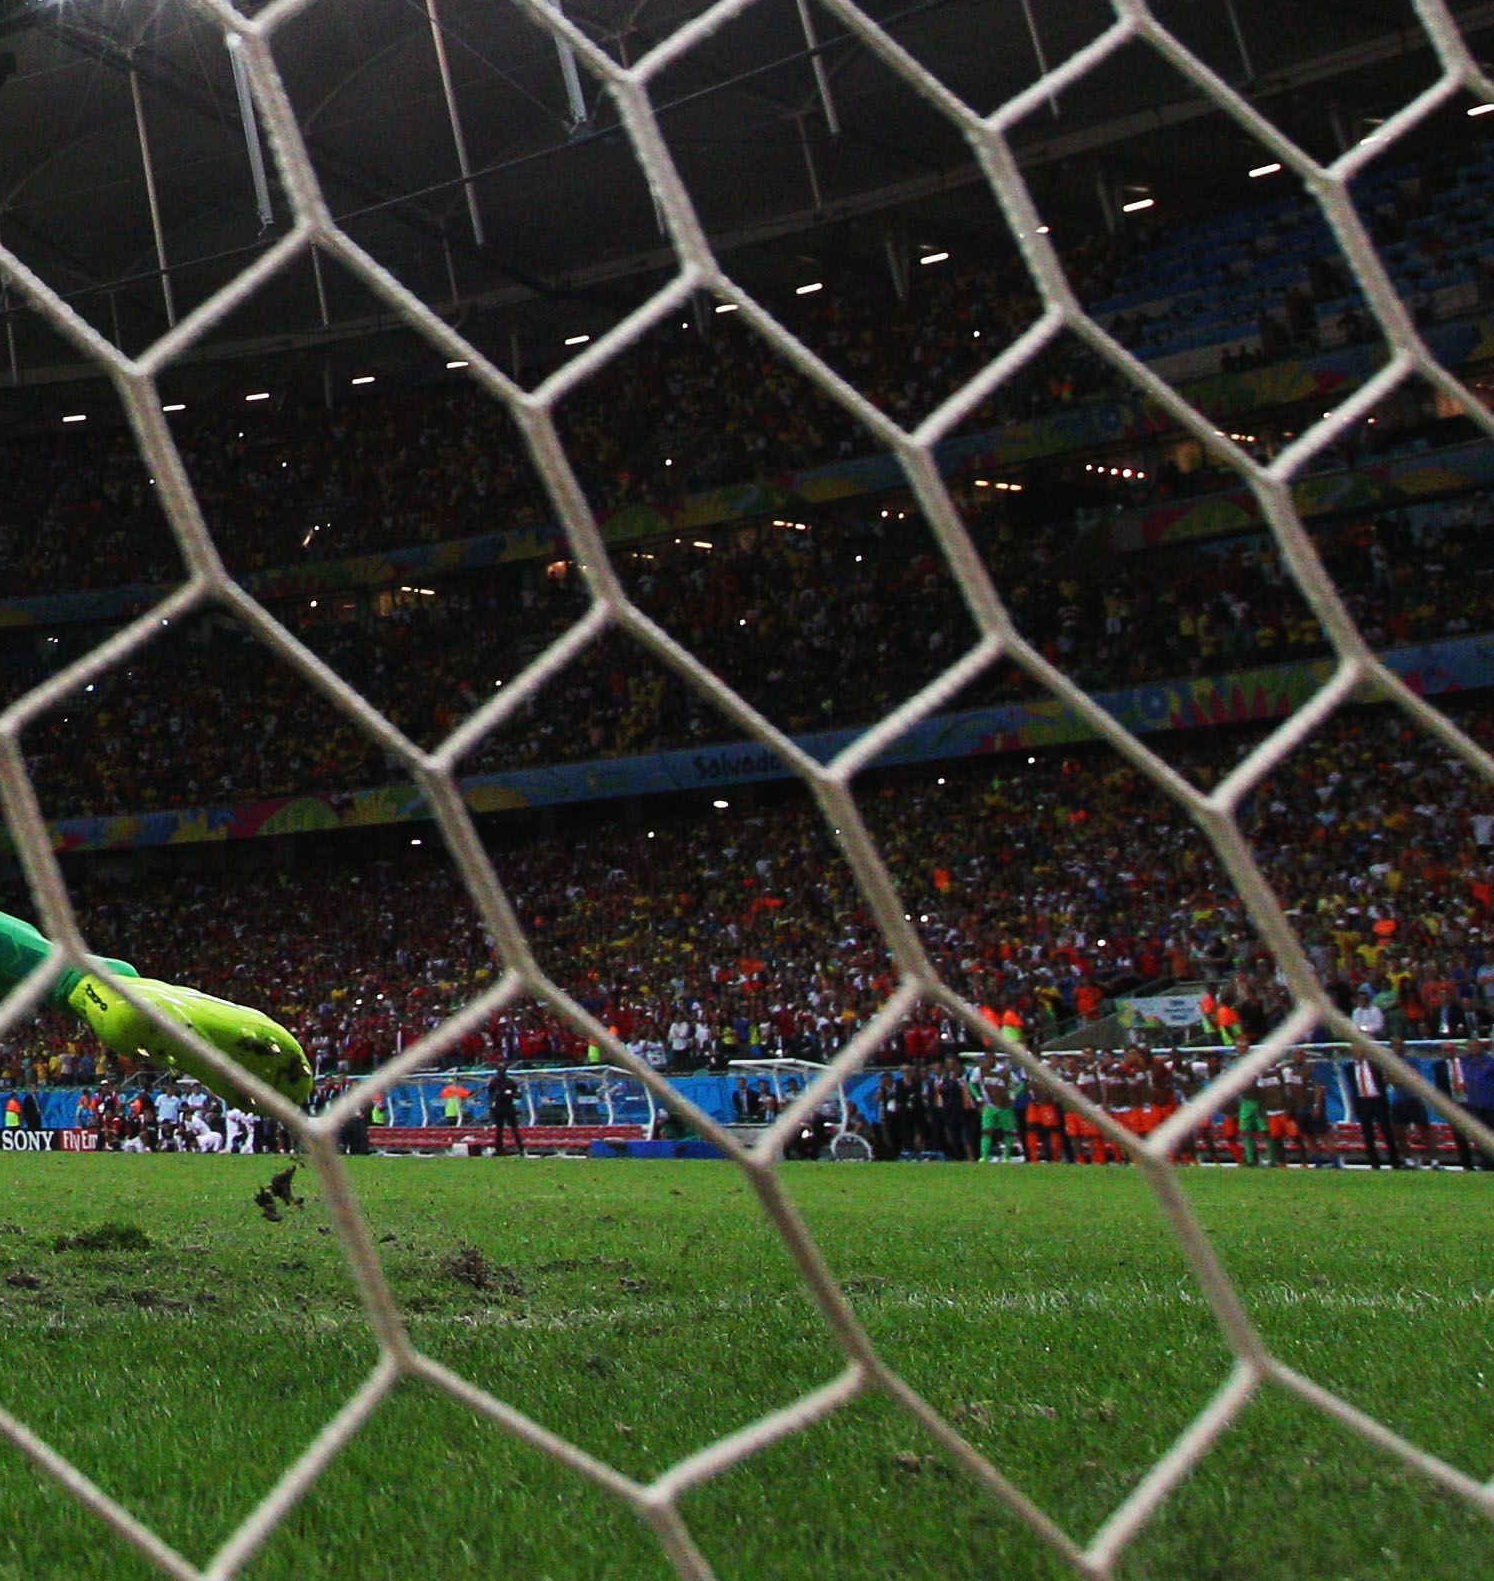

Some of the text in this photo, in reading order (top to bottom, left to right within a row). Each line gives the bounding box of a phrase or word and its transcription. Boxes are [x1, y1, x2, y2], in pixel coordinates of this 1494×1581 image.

[694, 749, 784, 778] Salvado
[1, 1129, 55, 1151] SONY
[63, 1130, 81, 1152] Fly
